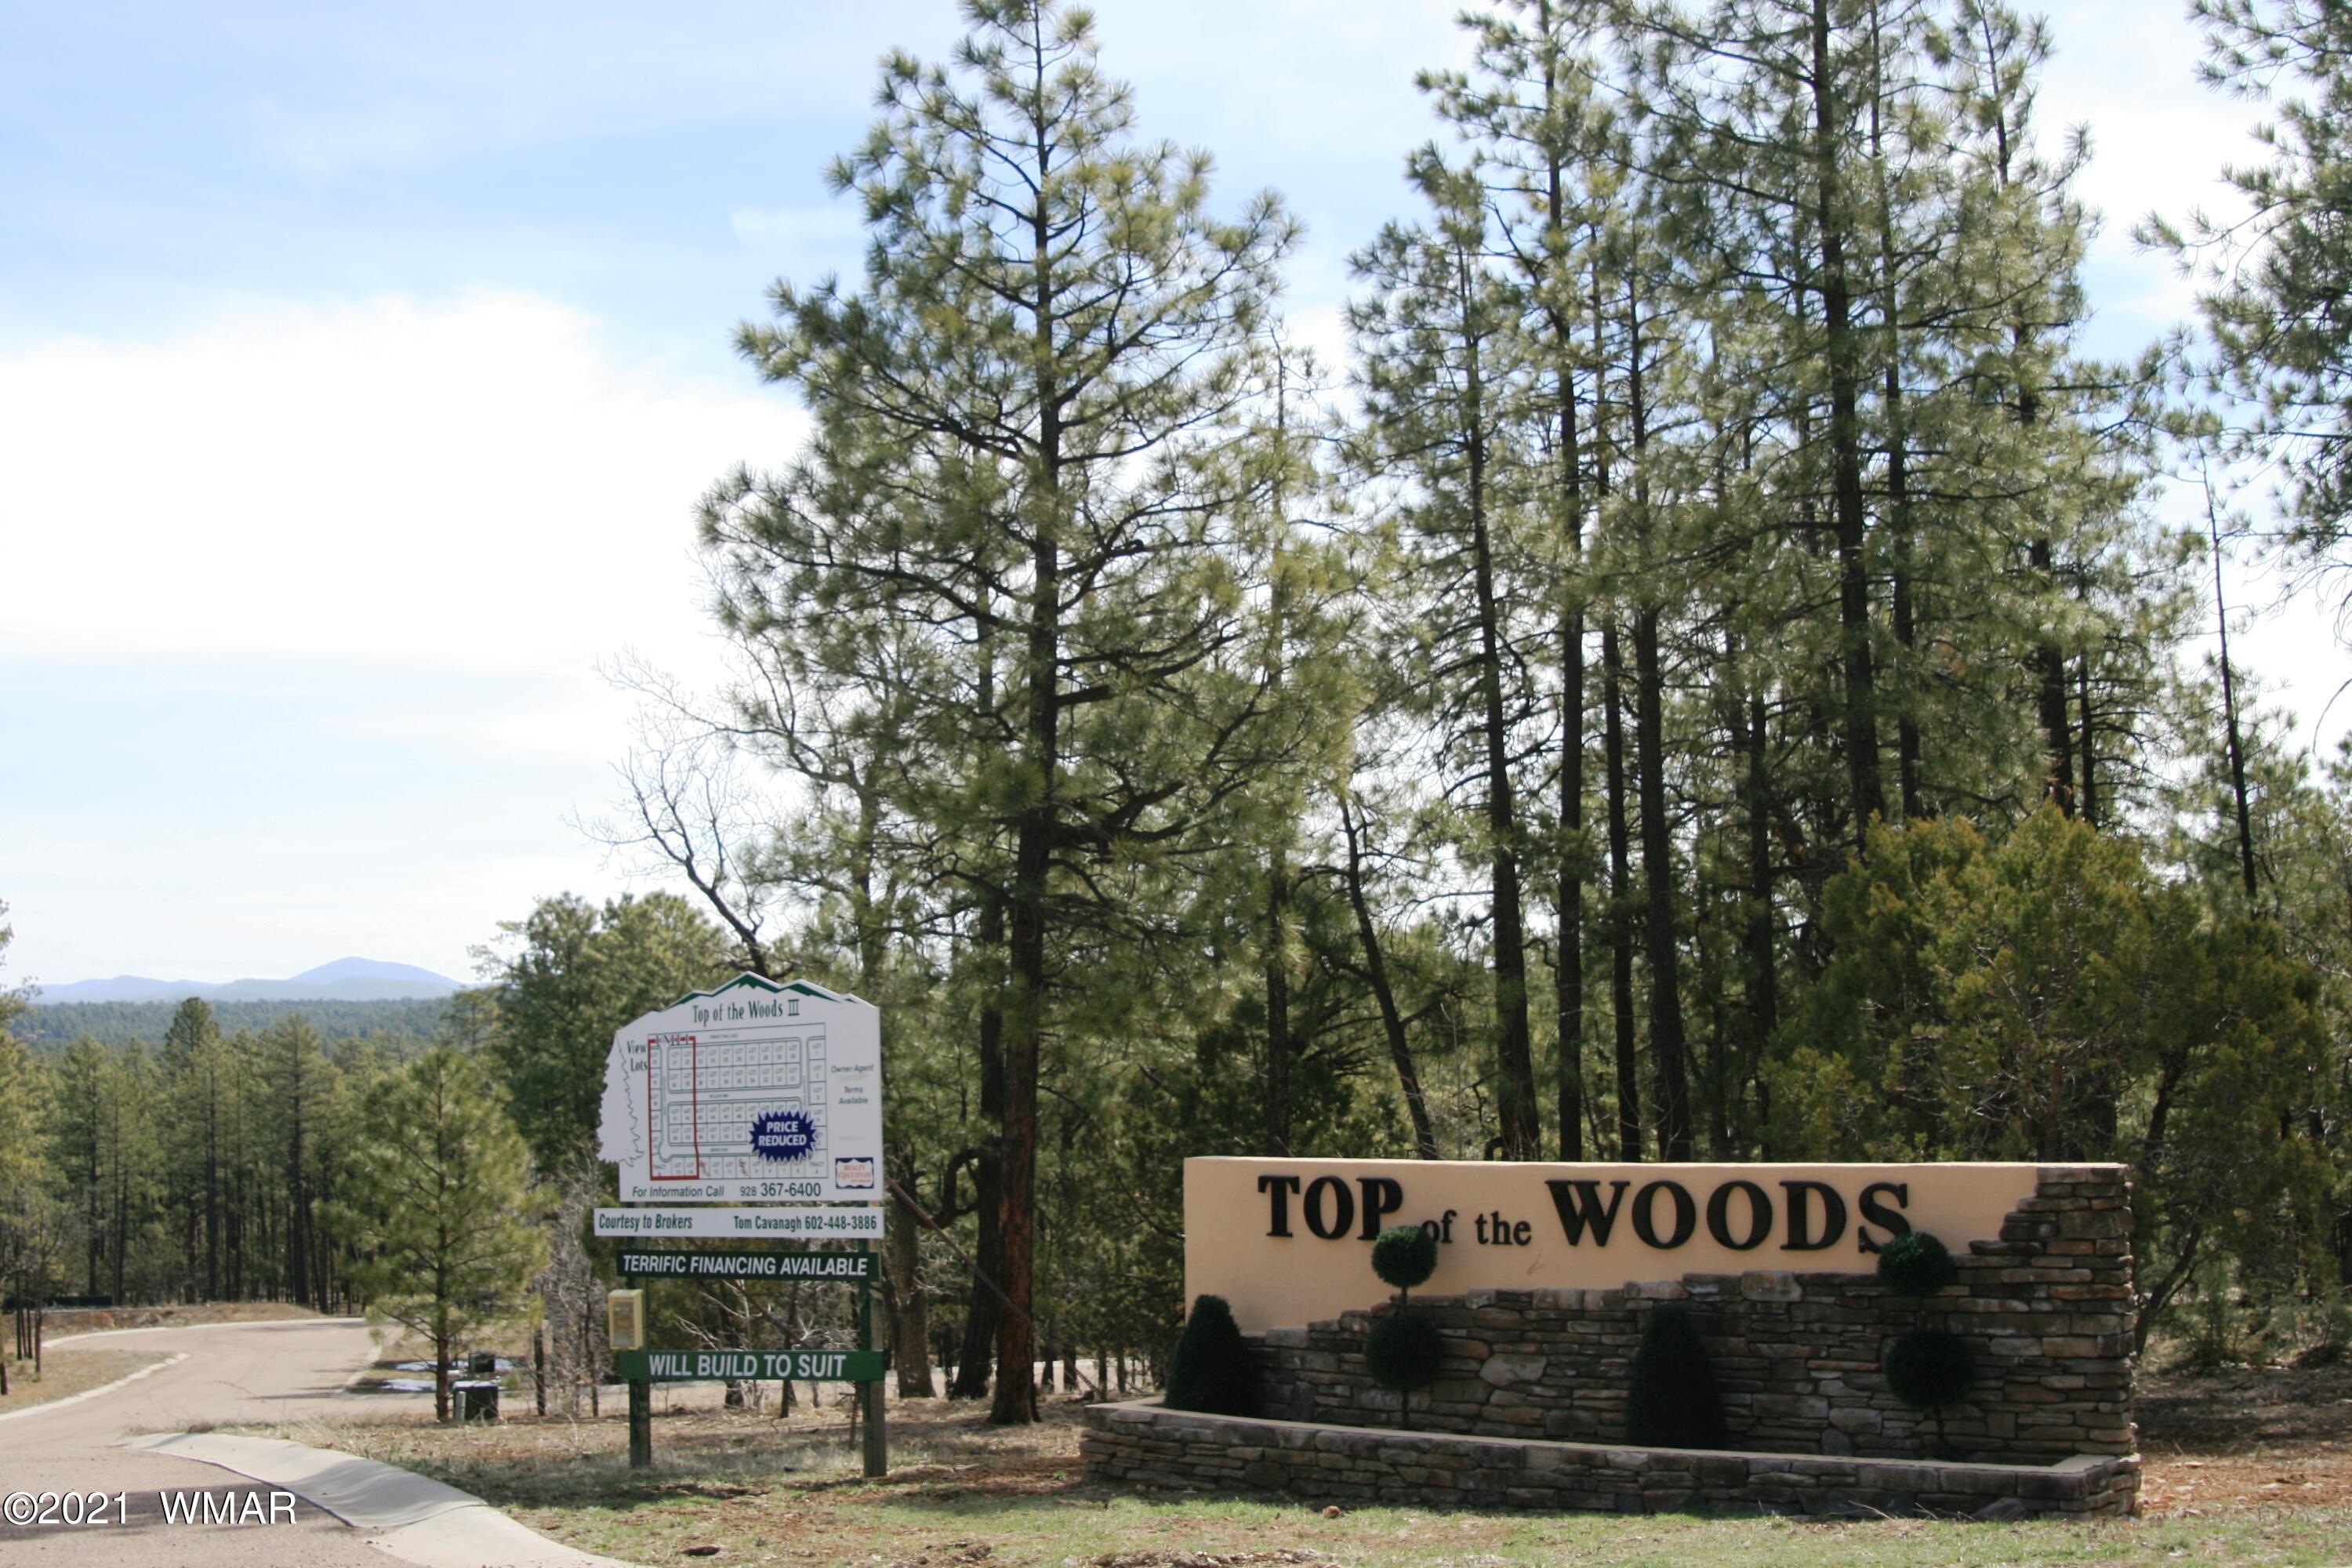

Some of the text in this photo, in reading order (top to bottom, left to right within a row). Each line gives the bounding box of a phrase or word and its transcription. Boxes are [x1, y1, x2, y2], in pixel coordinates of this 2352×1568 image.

[692, 999, 800, 1026] Top of the Woods III
[627, 1040, 647, 1054] View
[630, 1058, 648, 1073] Lots
[766, 1121, 799, 1133] PRICE
[758, 1134, 808, 1146] REDUCED
[632, 1185, 724, 1198] For Information Call
[740, 1182, 822, 1197] 928 367-6400
[599, 1214, 693, 1231] Courtesy to Brokers
[1258, 1174, 1911, 1256] TOP of the WOODS
[734, 1215, 877, 1232] Tom Cavanagh 602-448-3886
[623, 1254, 868, 1276] TERRIFIC FINANCING AVAILABLE
[649, 1354, 847, 1377] WILL BUILD TO SUIT
